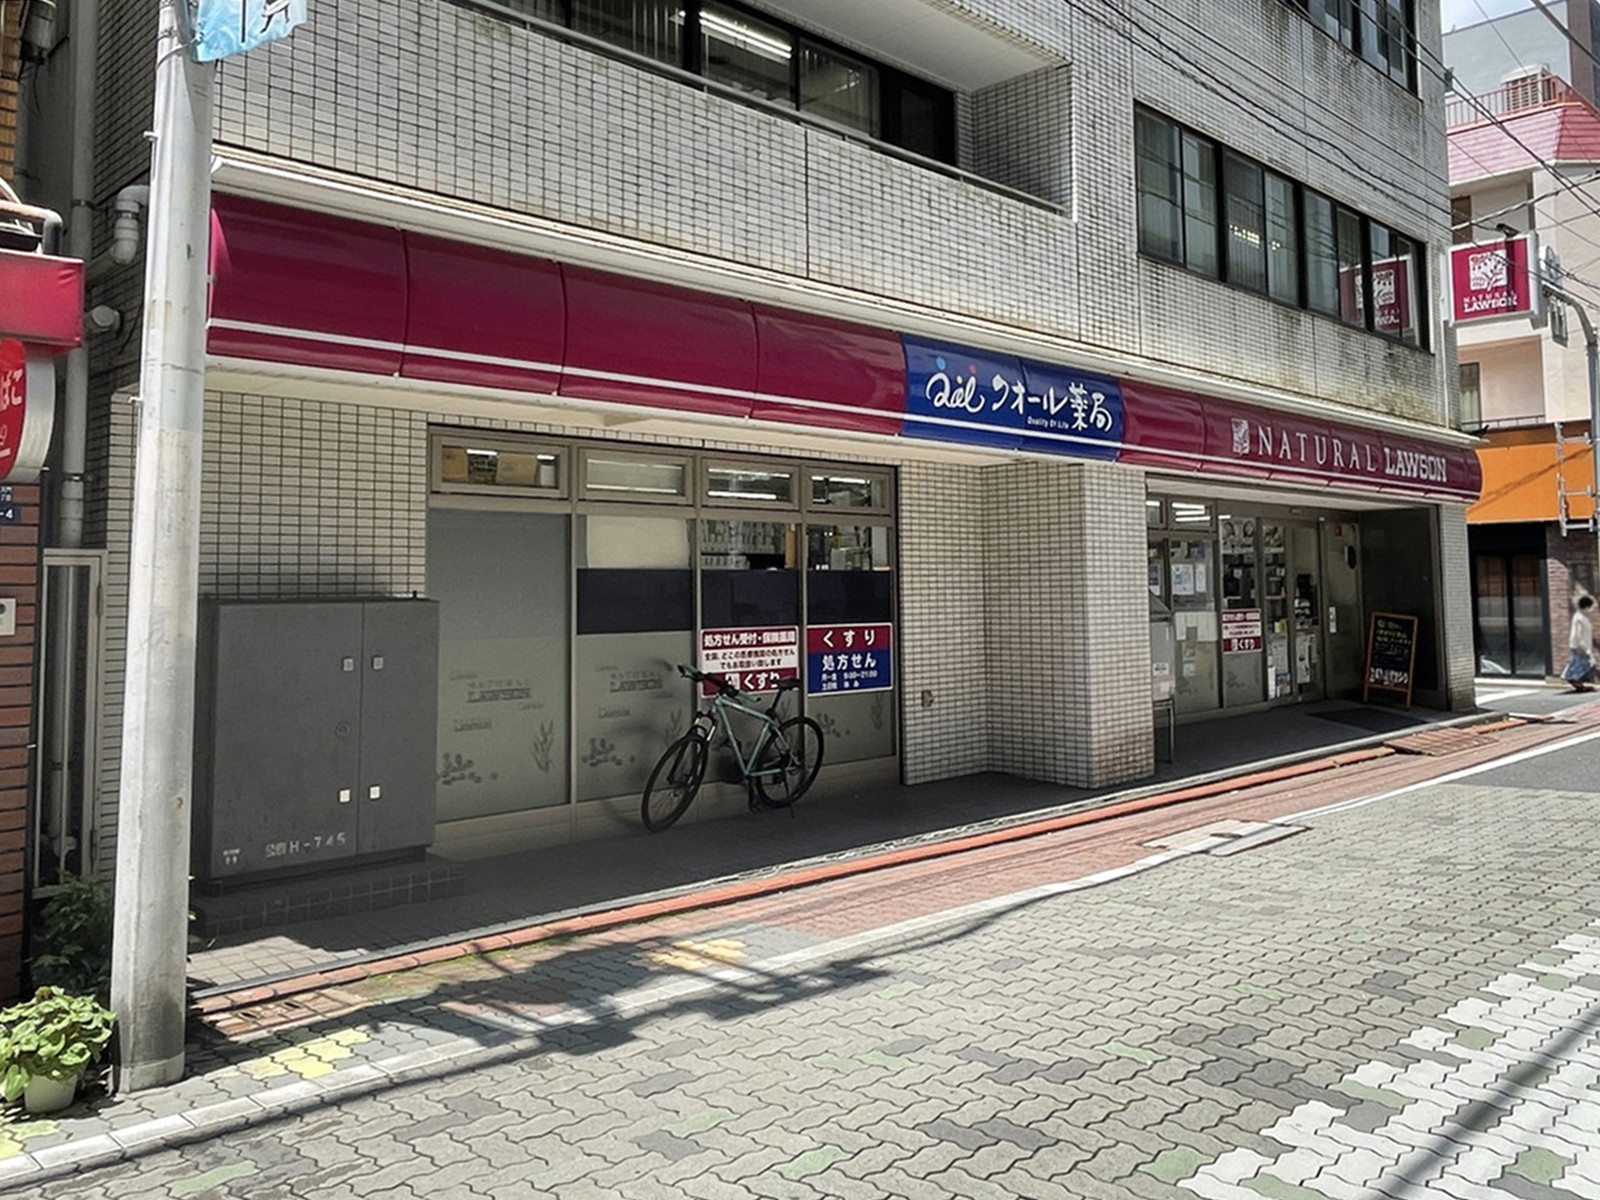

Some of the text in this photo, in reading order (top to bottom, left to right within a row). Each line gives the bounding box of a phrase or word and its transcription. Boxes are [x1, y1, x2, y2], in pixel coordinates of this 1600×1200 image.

[1464, 297, 1518, 313] LAWSON
[1258, 426, 1448, 483] NATURAL LAWSON
[823, 629, 876, 648] くすり
[822, 652, 876, 672] 処方せん
